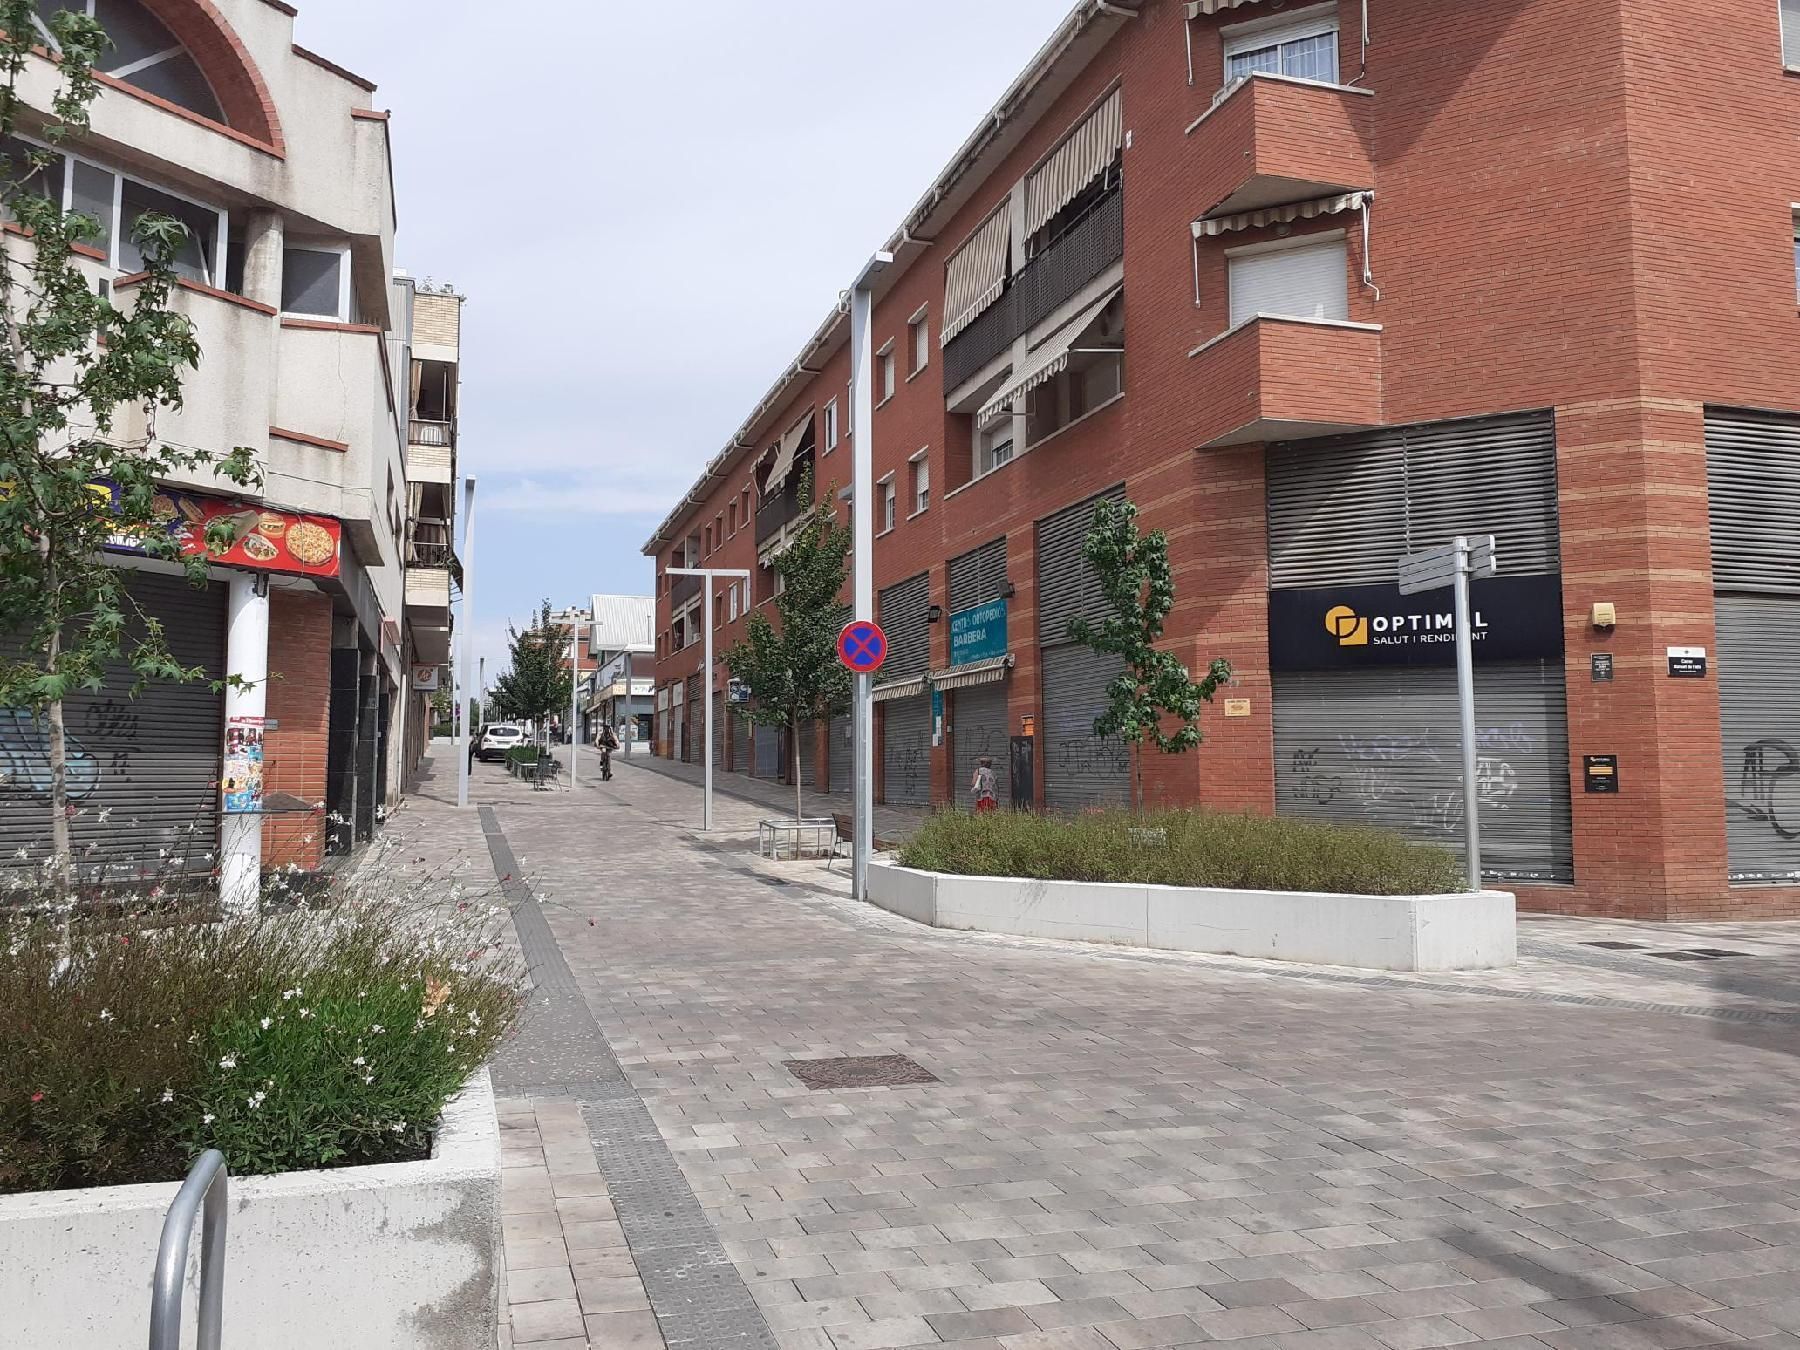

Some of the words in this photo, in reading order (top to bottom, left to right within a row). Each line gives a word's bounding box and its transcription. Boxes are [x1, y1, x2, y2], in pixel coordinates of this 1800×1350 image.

[1373, 611, 1488, 632] OPTIML
[1373, 635, 1409, 645] SALUT
[1420, 631, 1488, 643] RENDINT
